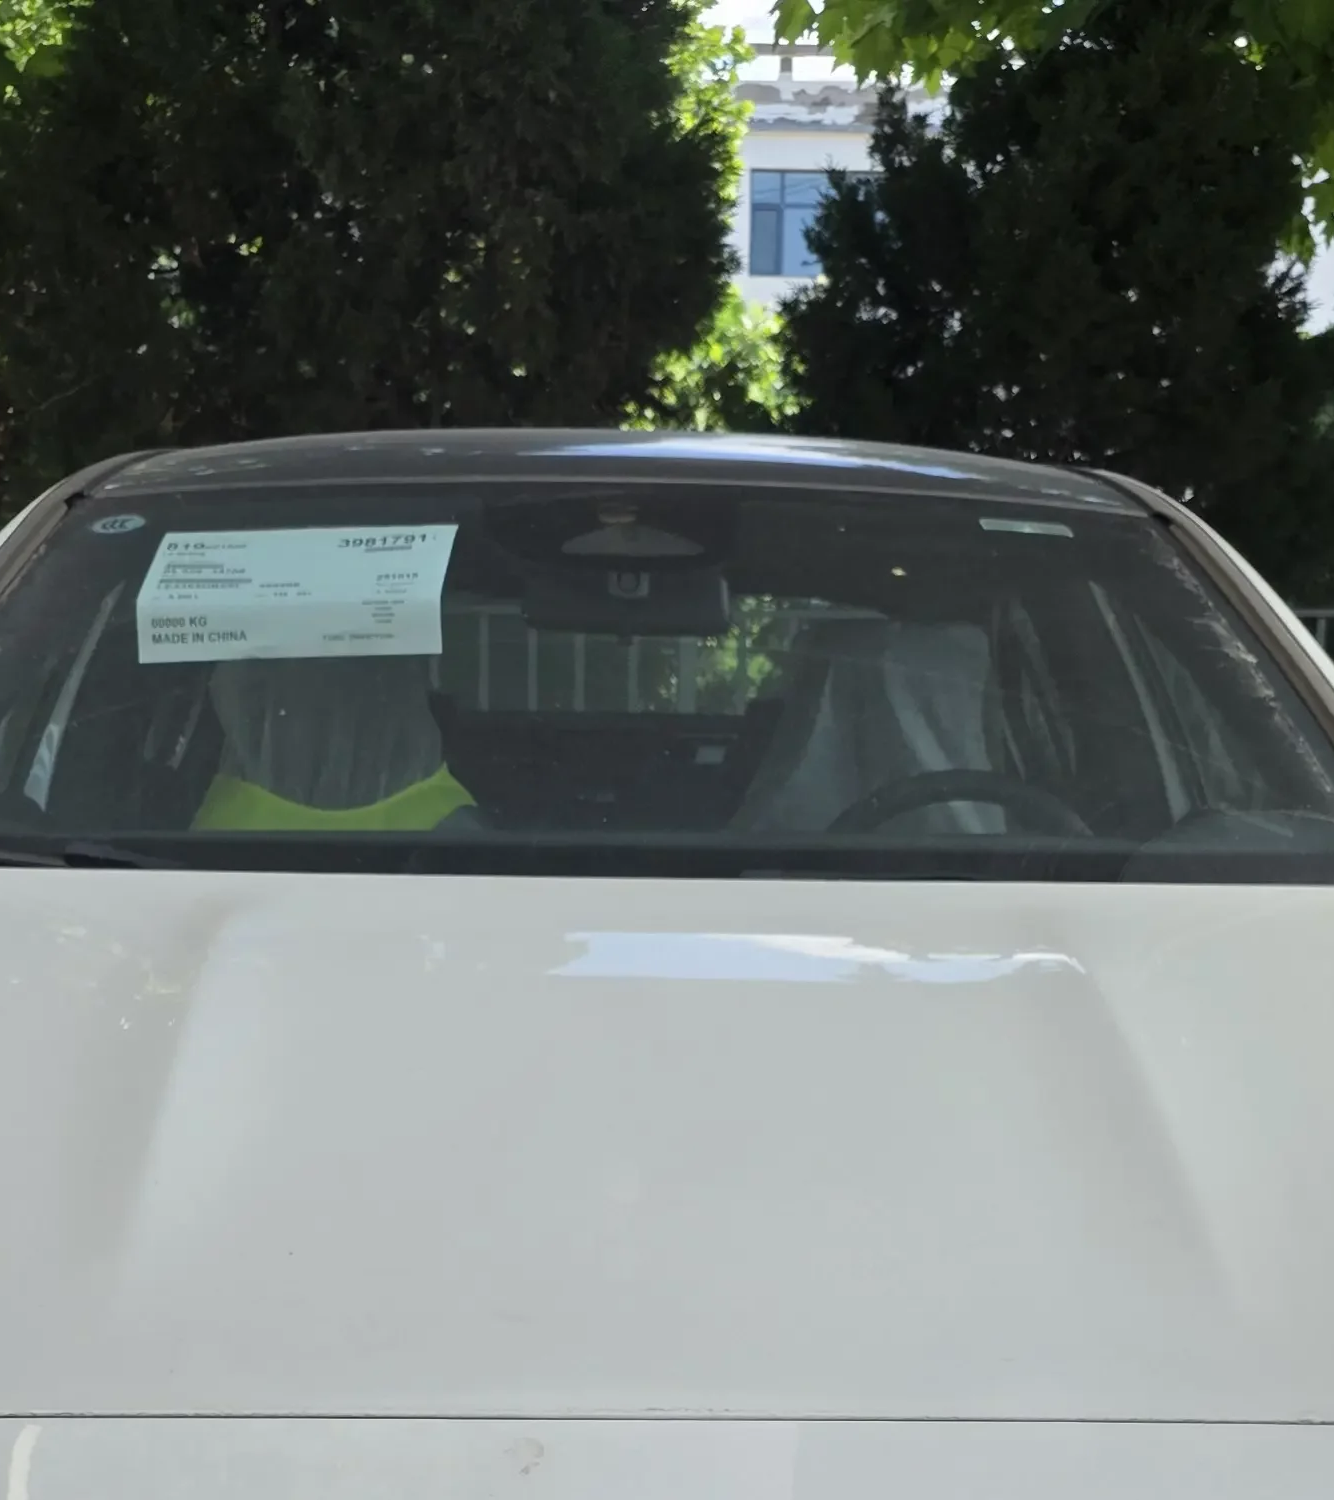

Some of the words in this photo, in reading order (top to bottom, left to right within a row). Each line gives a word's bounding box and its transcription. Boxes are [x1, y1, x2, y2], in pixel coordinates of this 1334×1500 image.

[189, 615, 208, 628] KG
[151, 632, 188, 645] MADE
[192, 631, 205, 644] IN
[208, 629, 247, 643] CHINA
